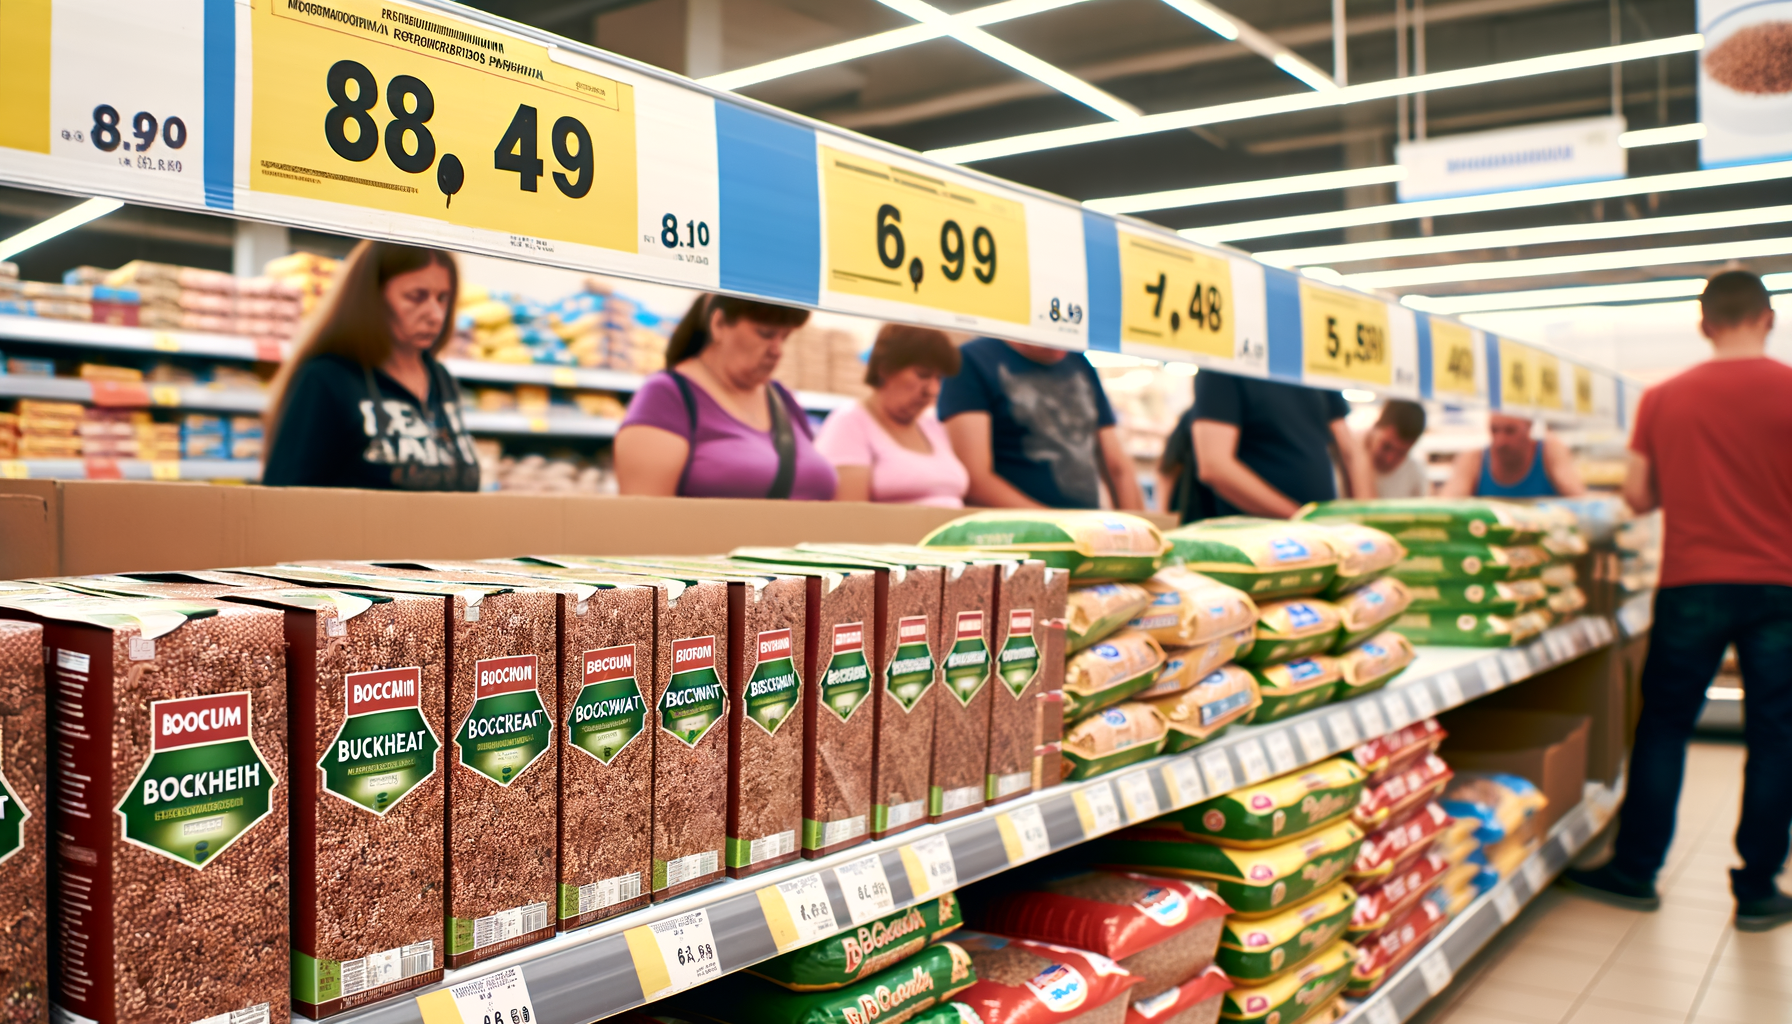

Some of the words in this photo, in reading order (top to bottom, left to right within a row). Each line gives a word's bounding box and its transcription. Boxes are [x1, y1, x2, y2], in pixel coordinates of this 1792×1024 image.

[90, 103, 187, 152] 8.90
[661, 212, 710, 249] 8.10
[161, 706, 242, 736] BOOCUM
[337, 730, 427, 763] BUCKHEAT
